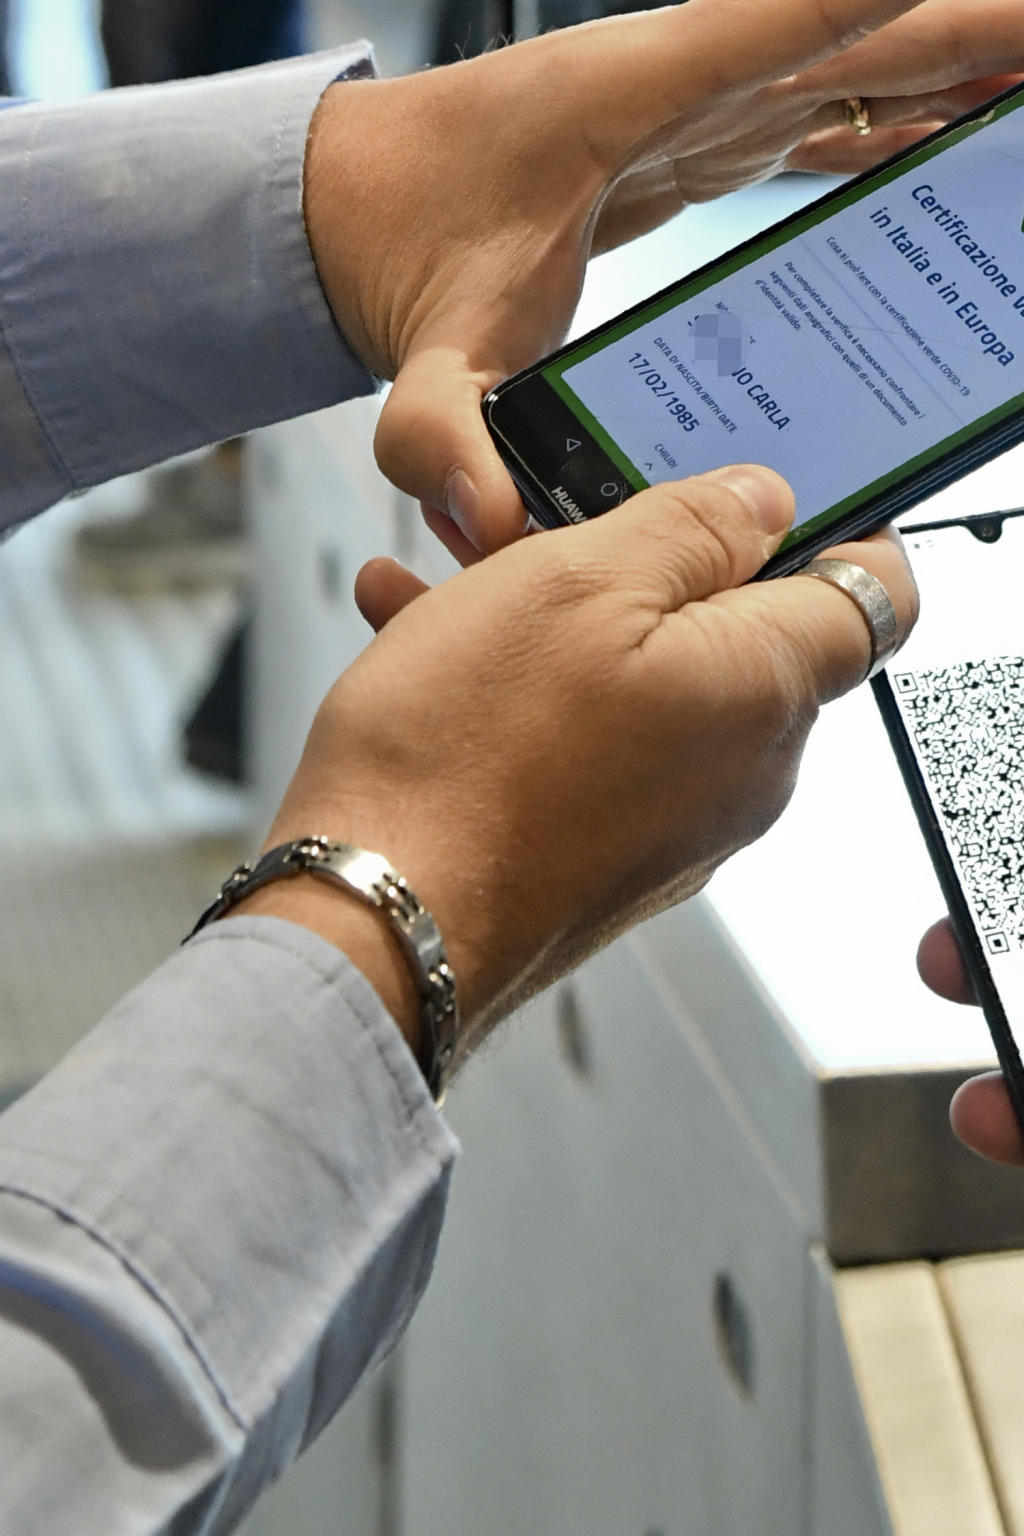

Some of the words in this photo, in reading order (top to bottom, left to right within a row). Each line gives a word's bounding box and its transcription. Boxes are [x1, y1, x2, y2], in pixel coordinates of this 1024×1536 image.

[869, 206, 892, 229] in
[885, 225, 931, 273] Italia
[925, 272, 943, 286] e
[937, 281, 960, 305] in
[954, 301, 1015, 367] Europa
[911, 184, 1017, 298] Certificazione
[754, 279, 785, 310] d'identità
[783, 261, 798, 274] Per
[793, 273, 828, 310] completare
[830, 315, 854, 340] verifica
[855, 343, 888, 378] necessario
[885, 377, 921, 416] confrontare
[826, 236, 843, 255] Cosa
[843, 259, 862, 273] può
[856, 271, 872, 287] fare
[868, 284, 882, 299] con
[884, 304, 925, 347] certificazione
[922, 345, 942, 365] verde
[939, 363, 971, 397] COVID-19
[628, 352, 700, 432] 17/02/1985
[653, 337, 673, 357] DATA
[674, 363, 723, 416] NASCITA/BIRTH
[717, 413, 738, 434] DATE
[769, 270, 796, 299] seguenti
[792, 297, 808, 312] dati
[804, 310, 836, 342] anagrafici
[831, 341, 845, 355] con
[841, 353, 861, 373] quelli
[872, 388, 908, 427] documento
[654, 443, 679, 469] CHIUDI
[746, 384, 791, 431] CARLA
